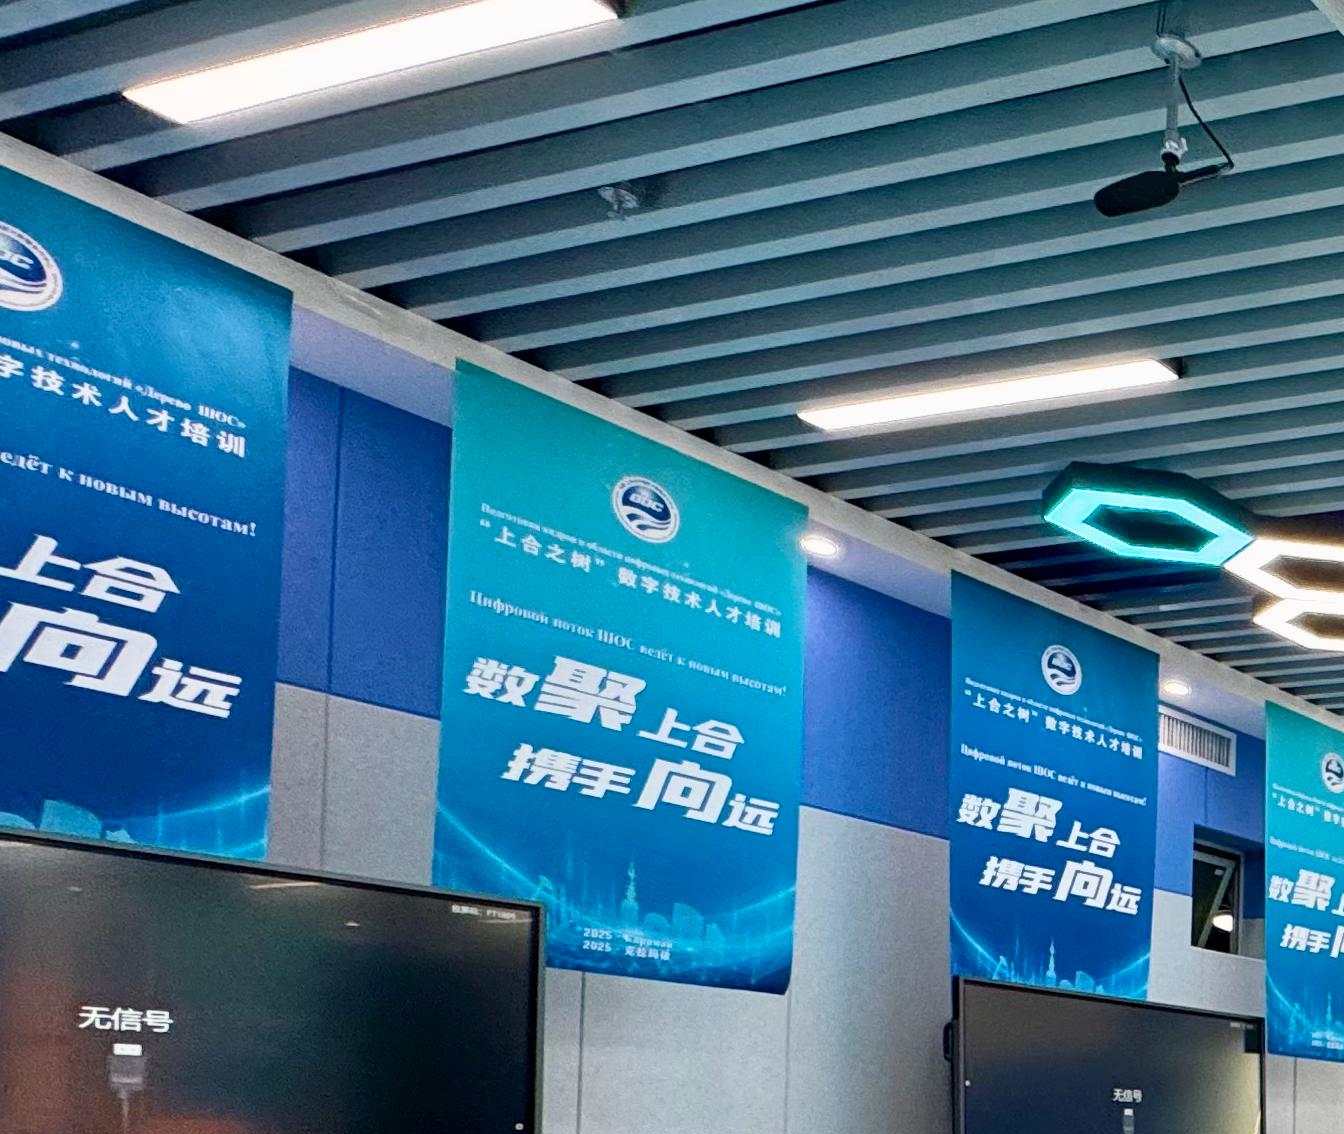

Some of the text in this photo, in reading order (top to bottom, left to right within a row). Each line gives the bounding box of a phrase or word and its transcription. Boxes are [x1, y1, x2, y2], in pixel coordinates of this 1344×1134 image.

[0, 451, 256, 537] едёт к новым высотам!
[470, 589, 549, 625] Цифровой
[597, 628, 634, 650] ШОС
[463, 655, 745, 760] 数聚上合
[501, 741, 780, 836] 携手向远
[956, 786, 1122, 859] 数聚上合
[978, 854, 1143, 916] 携手向远
[78, 1005, 174, 1034] 无信号
[1112, 1088, 1143, 1103] 无信号
